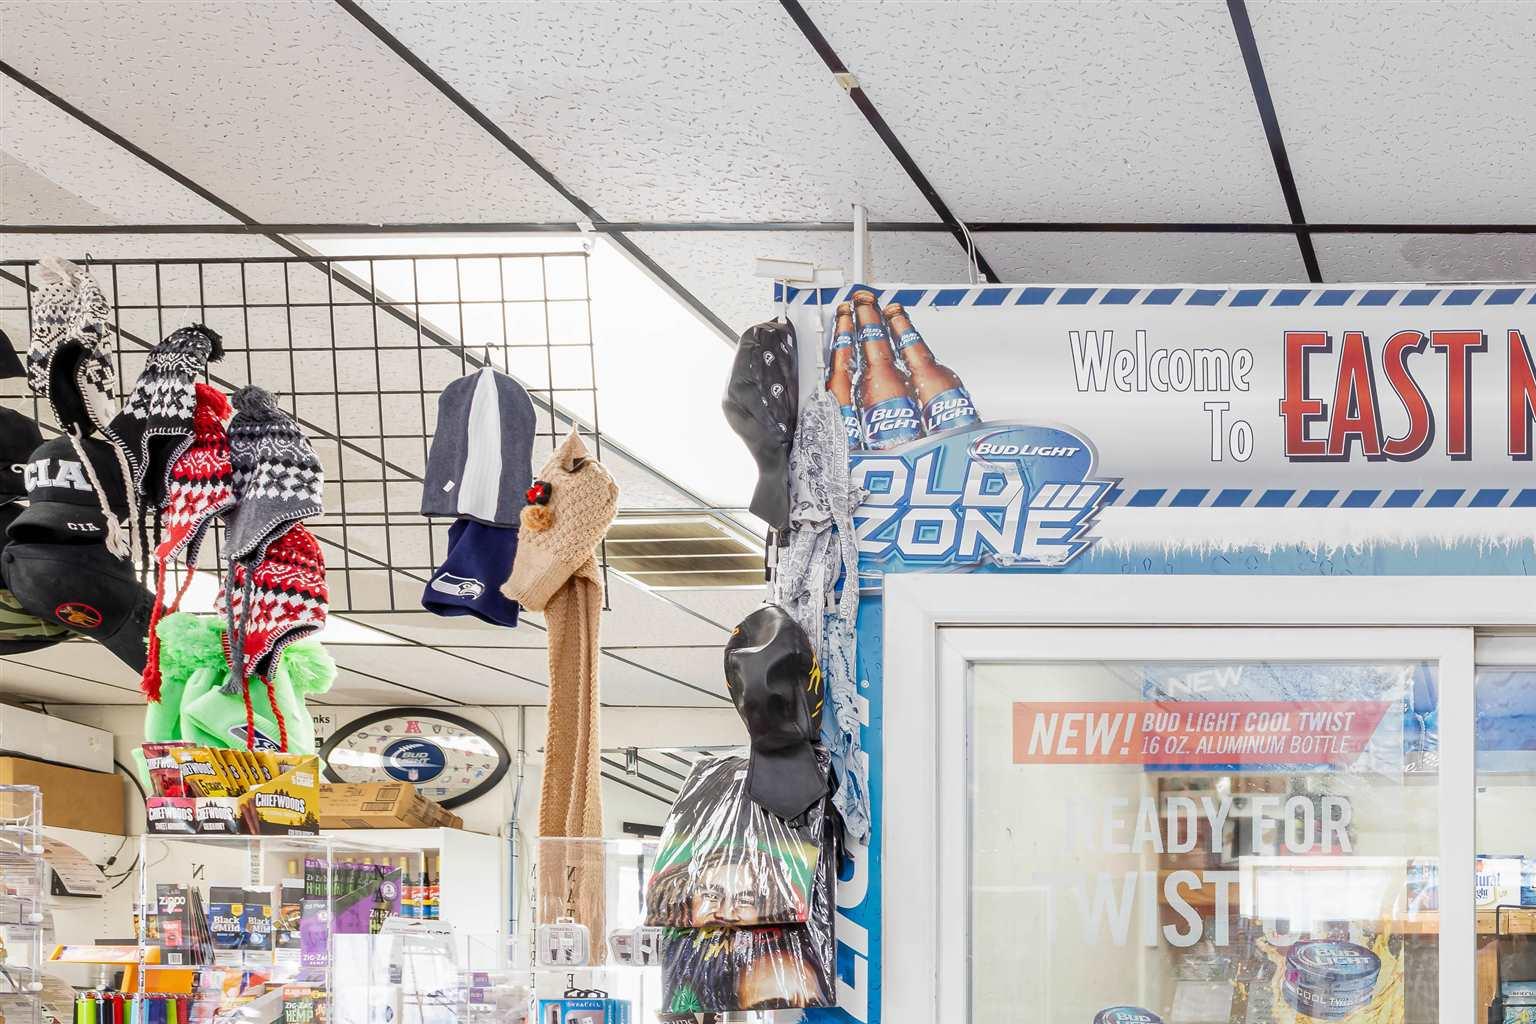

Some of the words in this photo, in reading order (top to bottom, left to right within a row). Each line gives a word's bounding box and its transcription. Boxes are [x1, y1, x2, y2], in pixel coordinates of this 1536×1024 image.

[1069, 330, 1254, 392] Welcome
[931, 398, 969, 416] BUD
[1279, 328, 1489, 462] EAST
[866, 418, 920, 436] LIGHT
[870, 408, 914, 423] BUD
[927, 406, 976, 431] LIGHT
[1204, 401, 1254, 462] To
[975, 443, 1022, 457] BUD
[1023, 444, 1080, 458] LIGHT
[24, 458, 93, 492] CIA
[851, 450, 1025, 510] OLD
[852, 500, 1098, 562] ZONE
[1141, 711, 1179, 732] BUD
[1185, 711, 1239, 732] LIGHT
[1244, 711, 1292, 732] COOL
[1299, 711, 1356, 732] TWIST
[1027, 712, 1136, 756] NEW!
[1141, 735, 1159, 754] 16
[1164, 735, 1191, 754] OZ.
[1195, 735, 1285, 754] ALUMINUM
[1290, 735, 1350, 754] BOTTLE
[255, 791, 305, 814] CHIEFWOODS
[1252, 796, 1353, 855] FOR
[213, 915, 239, 926] Black
[1117, 1012, 1151, 1022] BUD
